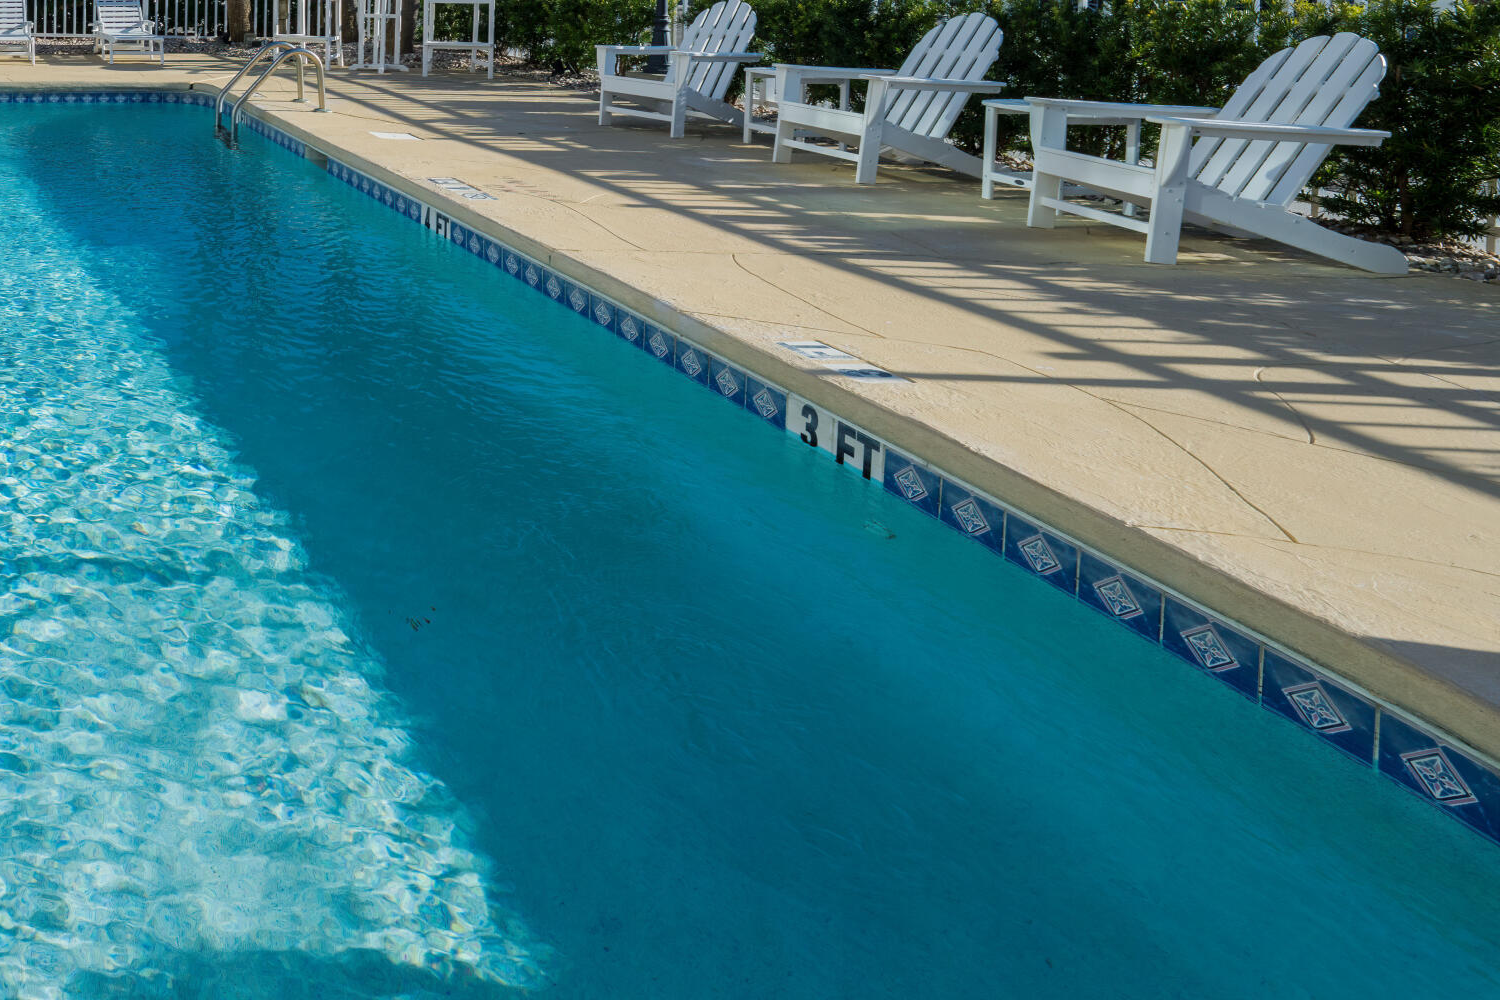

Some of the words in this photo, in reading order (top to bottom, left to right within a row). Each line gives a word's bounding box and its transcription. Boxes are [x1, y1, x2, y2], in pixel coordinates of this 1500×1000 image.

[424, 207, 431, 230] 4
[435, 211, 449, 239] FT
[800, 403, 818, 447] 3
[835, 421, 880, 481] FT
